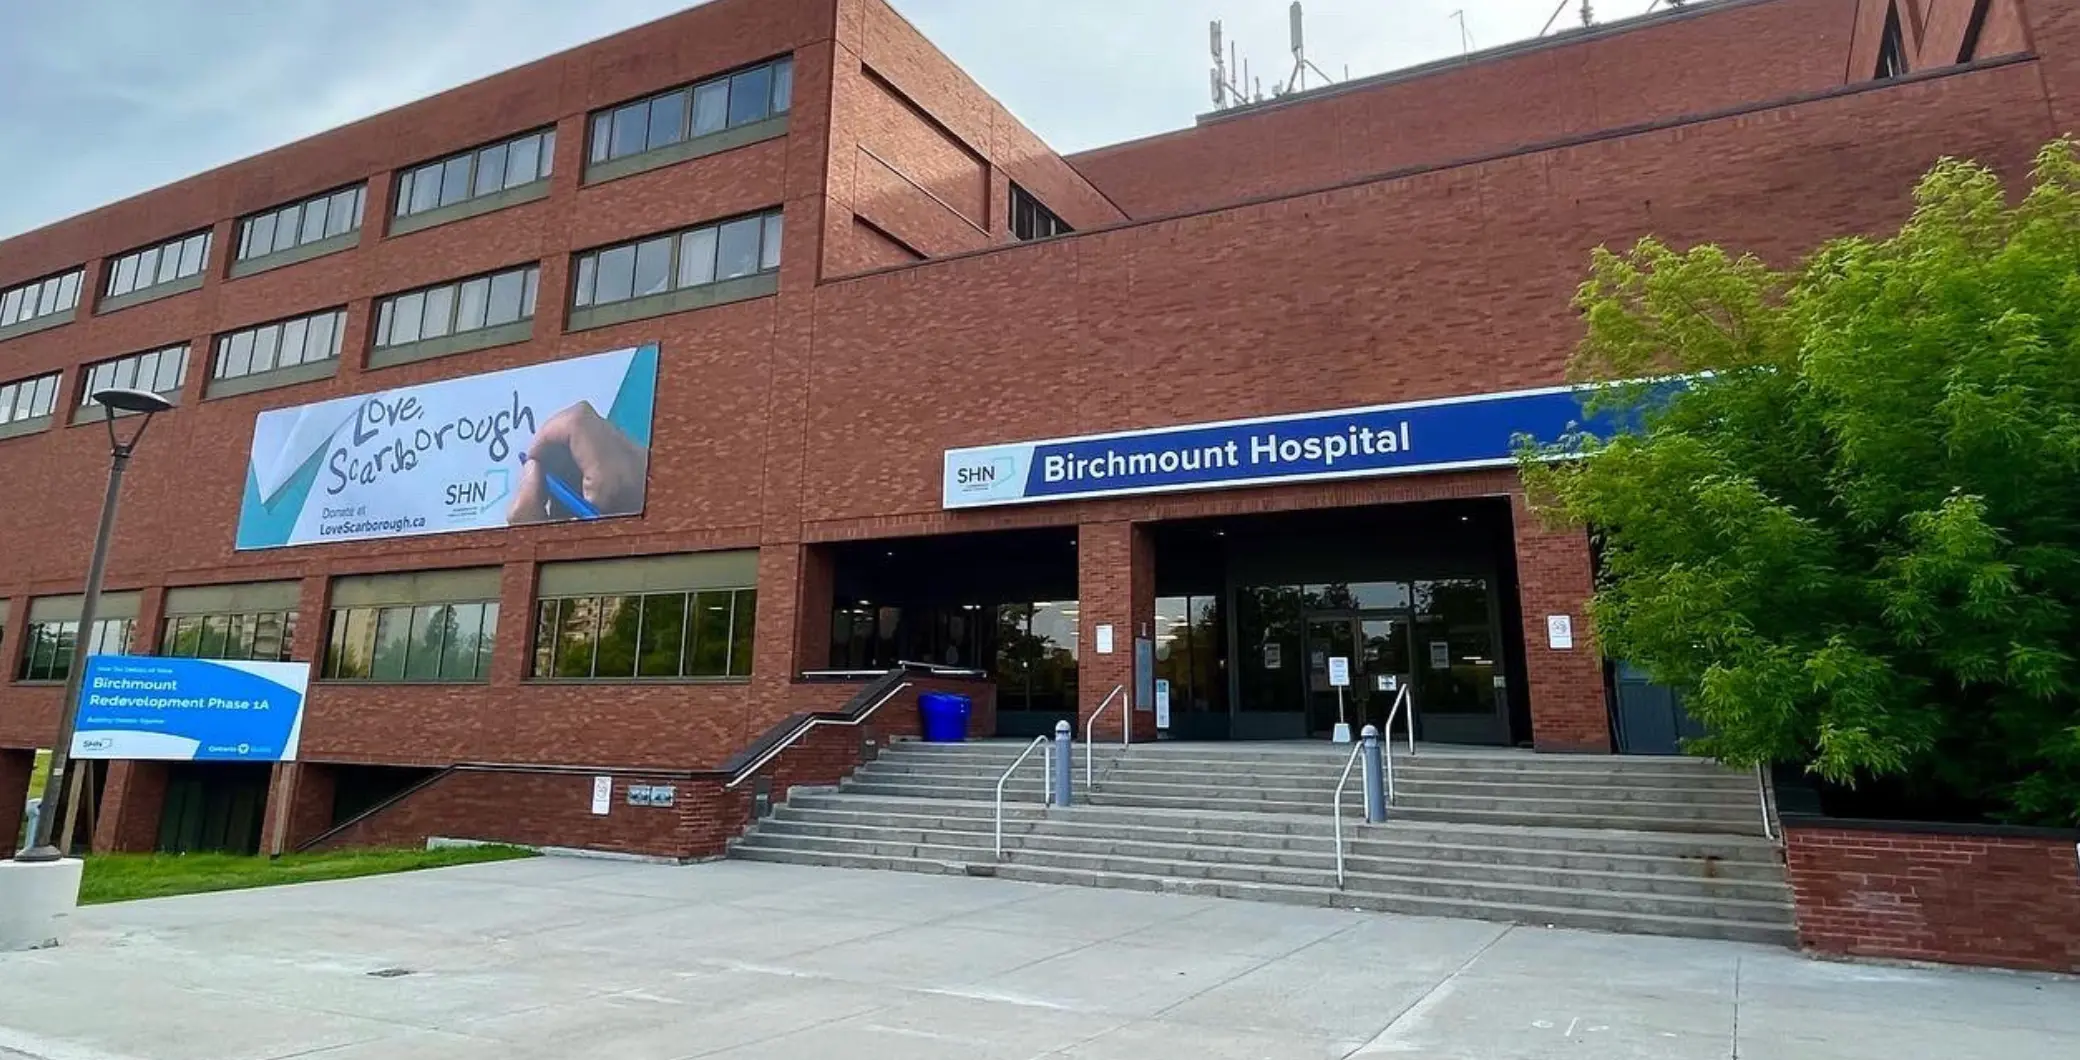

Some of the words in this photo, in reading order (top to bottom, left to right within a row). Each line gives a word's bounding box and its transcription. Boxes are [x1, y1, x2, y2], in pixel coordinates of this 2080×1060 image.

[327, 390, 536, 495] Scarborough
[1044, 440, 1239, 482] Birchmount
[1251, 421, 1410, 465] Hospital
[957, 465, 995, 484] SHN
[444, 480, 487, 506] SHN
[319, 516, 426, 536] LoveScarborough.ca
[93, 676, 177, 691] Birchmount
[89, 694, 204, 710] Redevelopment
[208, 697, 250, 710] Phase
[253, 699, 270, 710] 1A
